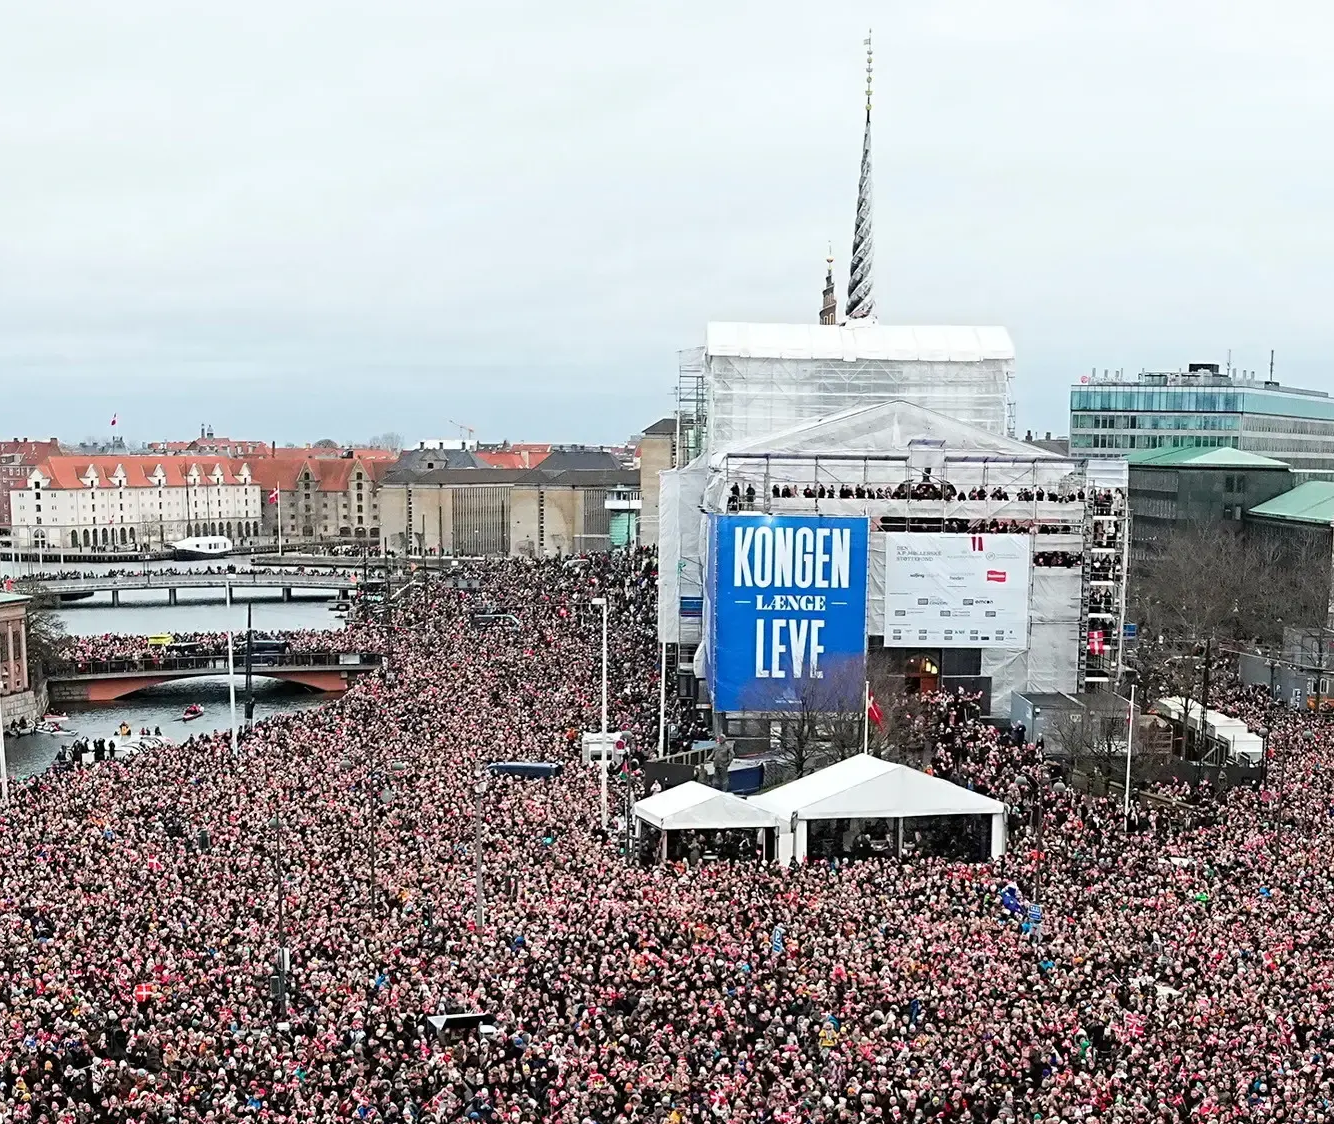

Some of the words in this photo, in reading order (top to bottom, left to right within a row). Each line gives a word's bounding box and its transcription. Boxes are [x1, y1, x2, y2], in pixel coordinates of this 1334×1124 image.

[734, 526, 850, 588] KONGEN
[756, 594, 826, 611] LÆNGE
[756, 618, 825, 679] LEVE
